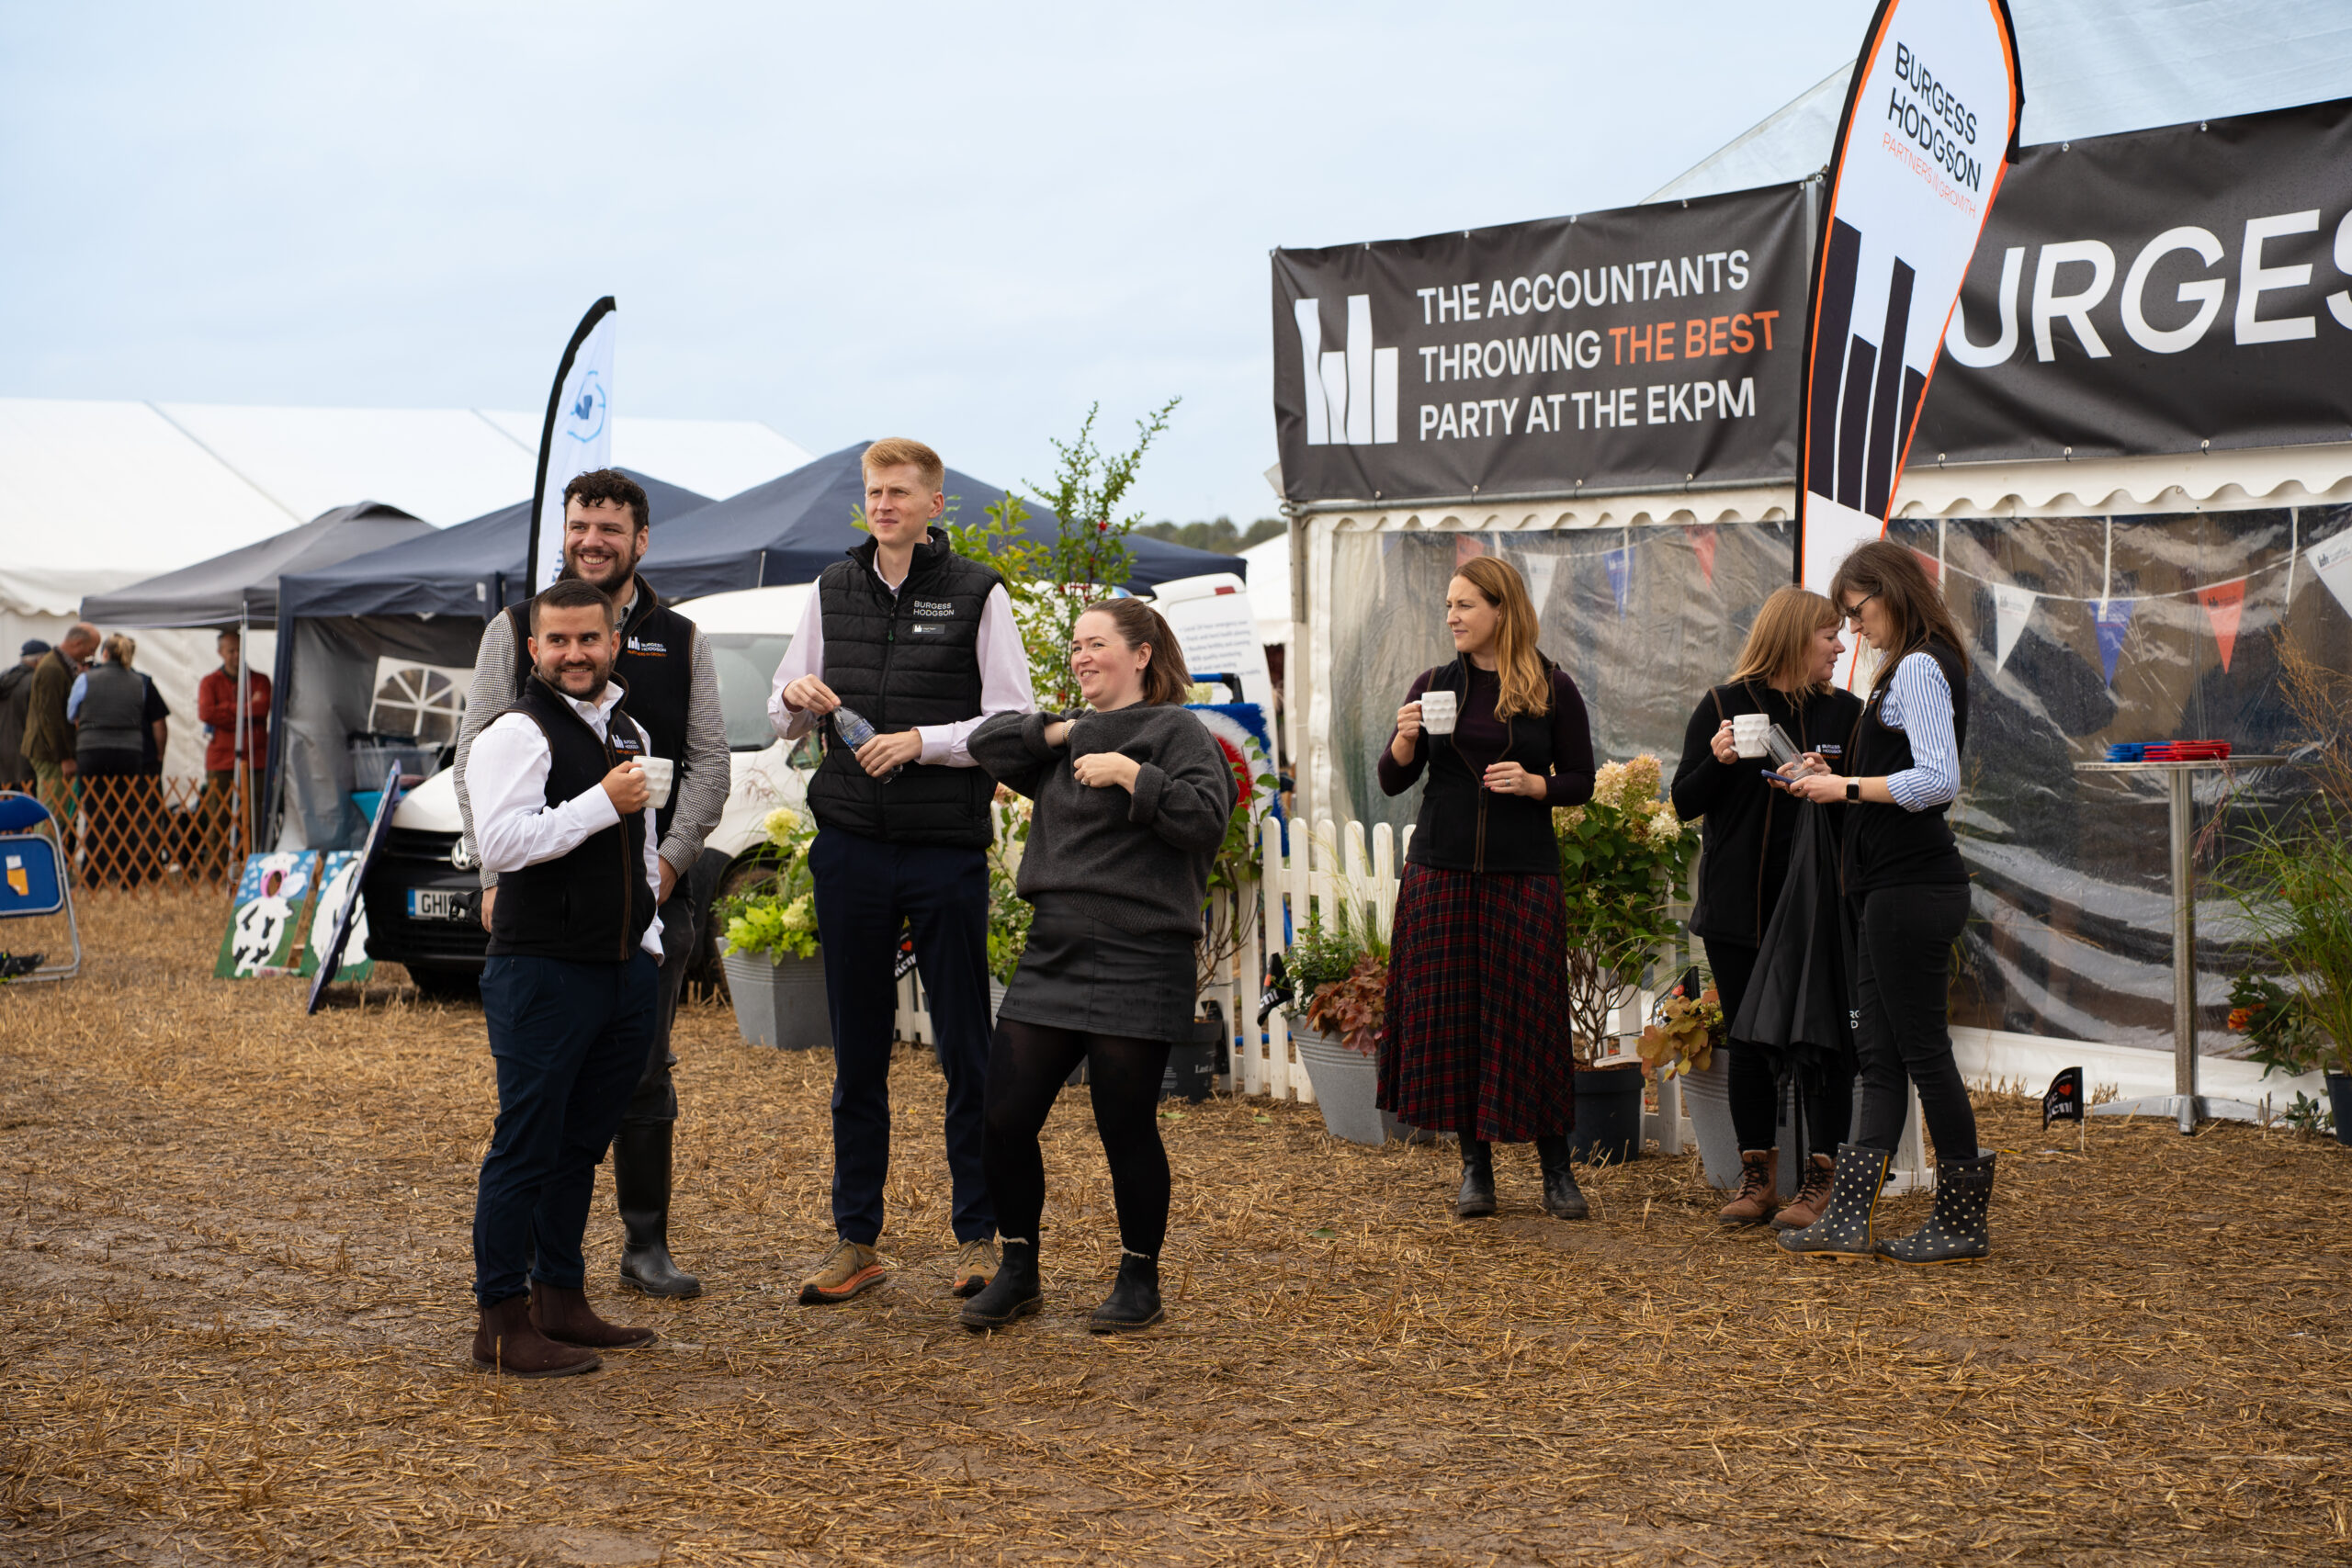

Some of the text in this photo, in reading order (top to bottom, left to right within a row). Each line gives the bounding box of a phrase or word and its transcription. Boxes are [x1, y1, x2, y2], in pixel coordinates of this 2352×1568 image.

[1895, 41, 1977, 145] BURGESS
[1883, 131, 1977, 220] PARTNERS IN GROWTH
[1888, 86, 1982, 193] HODGSON
[1417, 249, 1750, 325] THE ACCOUNTANTS
[1944, 209, 2352, 367] URGE
[1419, 310, 1780, 383] THROWING THE BEST
[1419, 378, 1756, 441] PARTY AT THE EKPM
[913, 600, 952, 610] BURGESS
[913, 608, 955, 616] HODGSON
